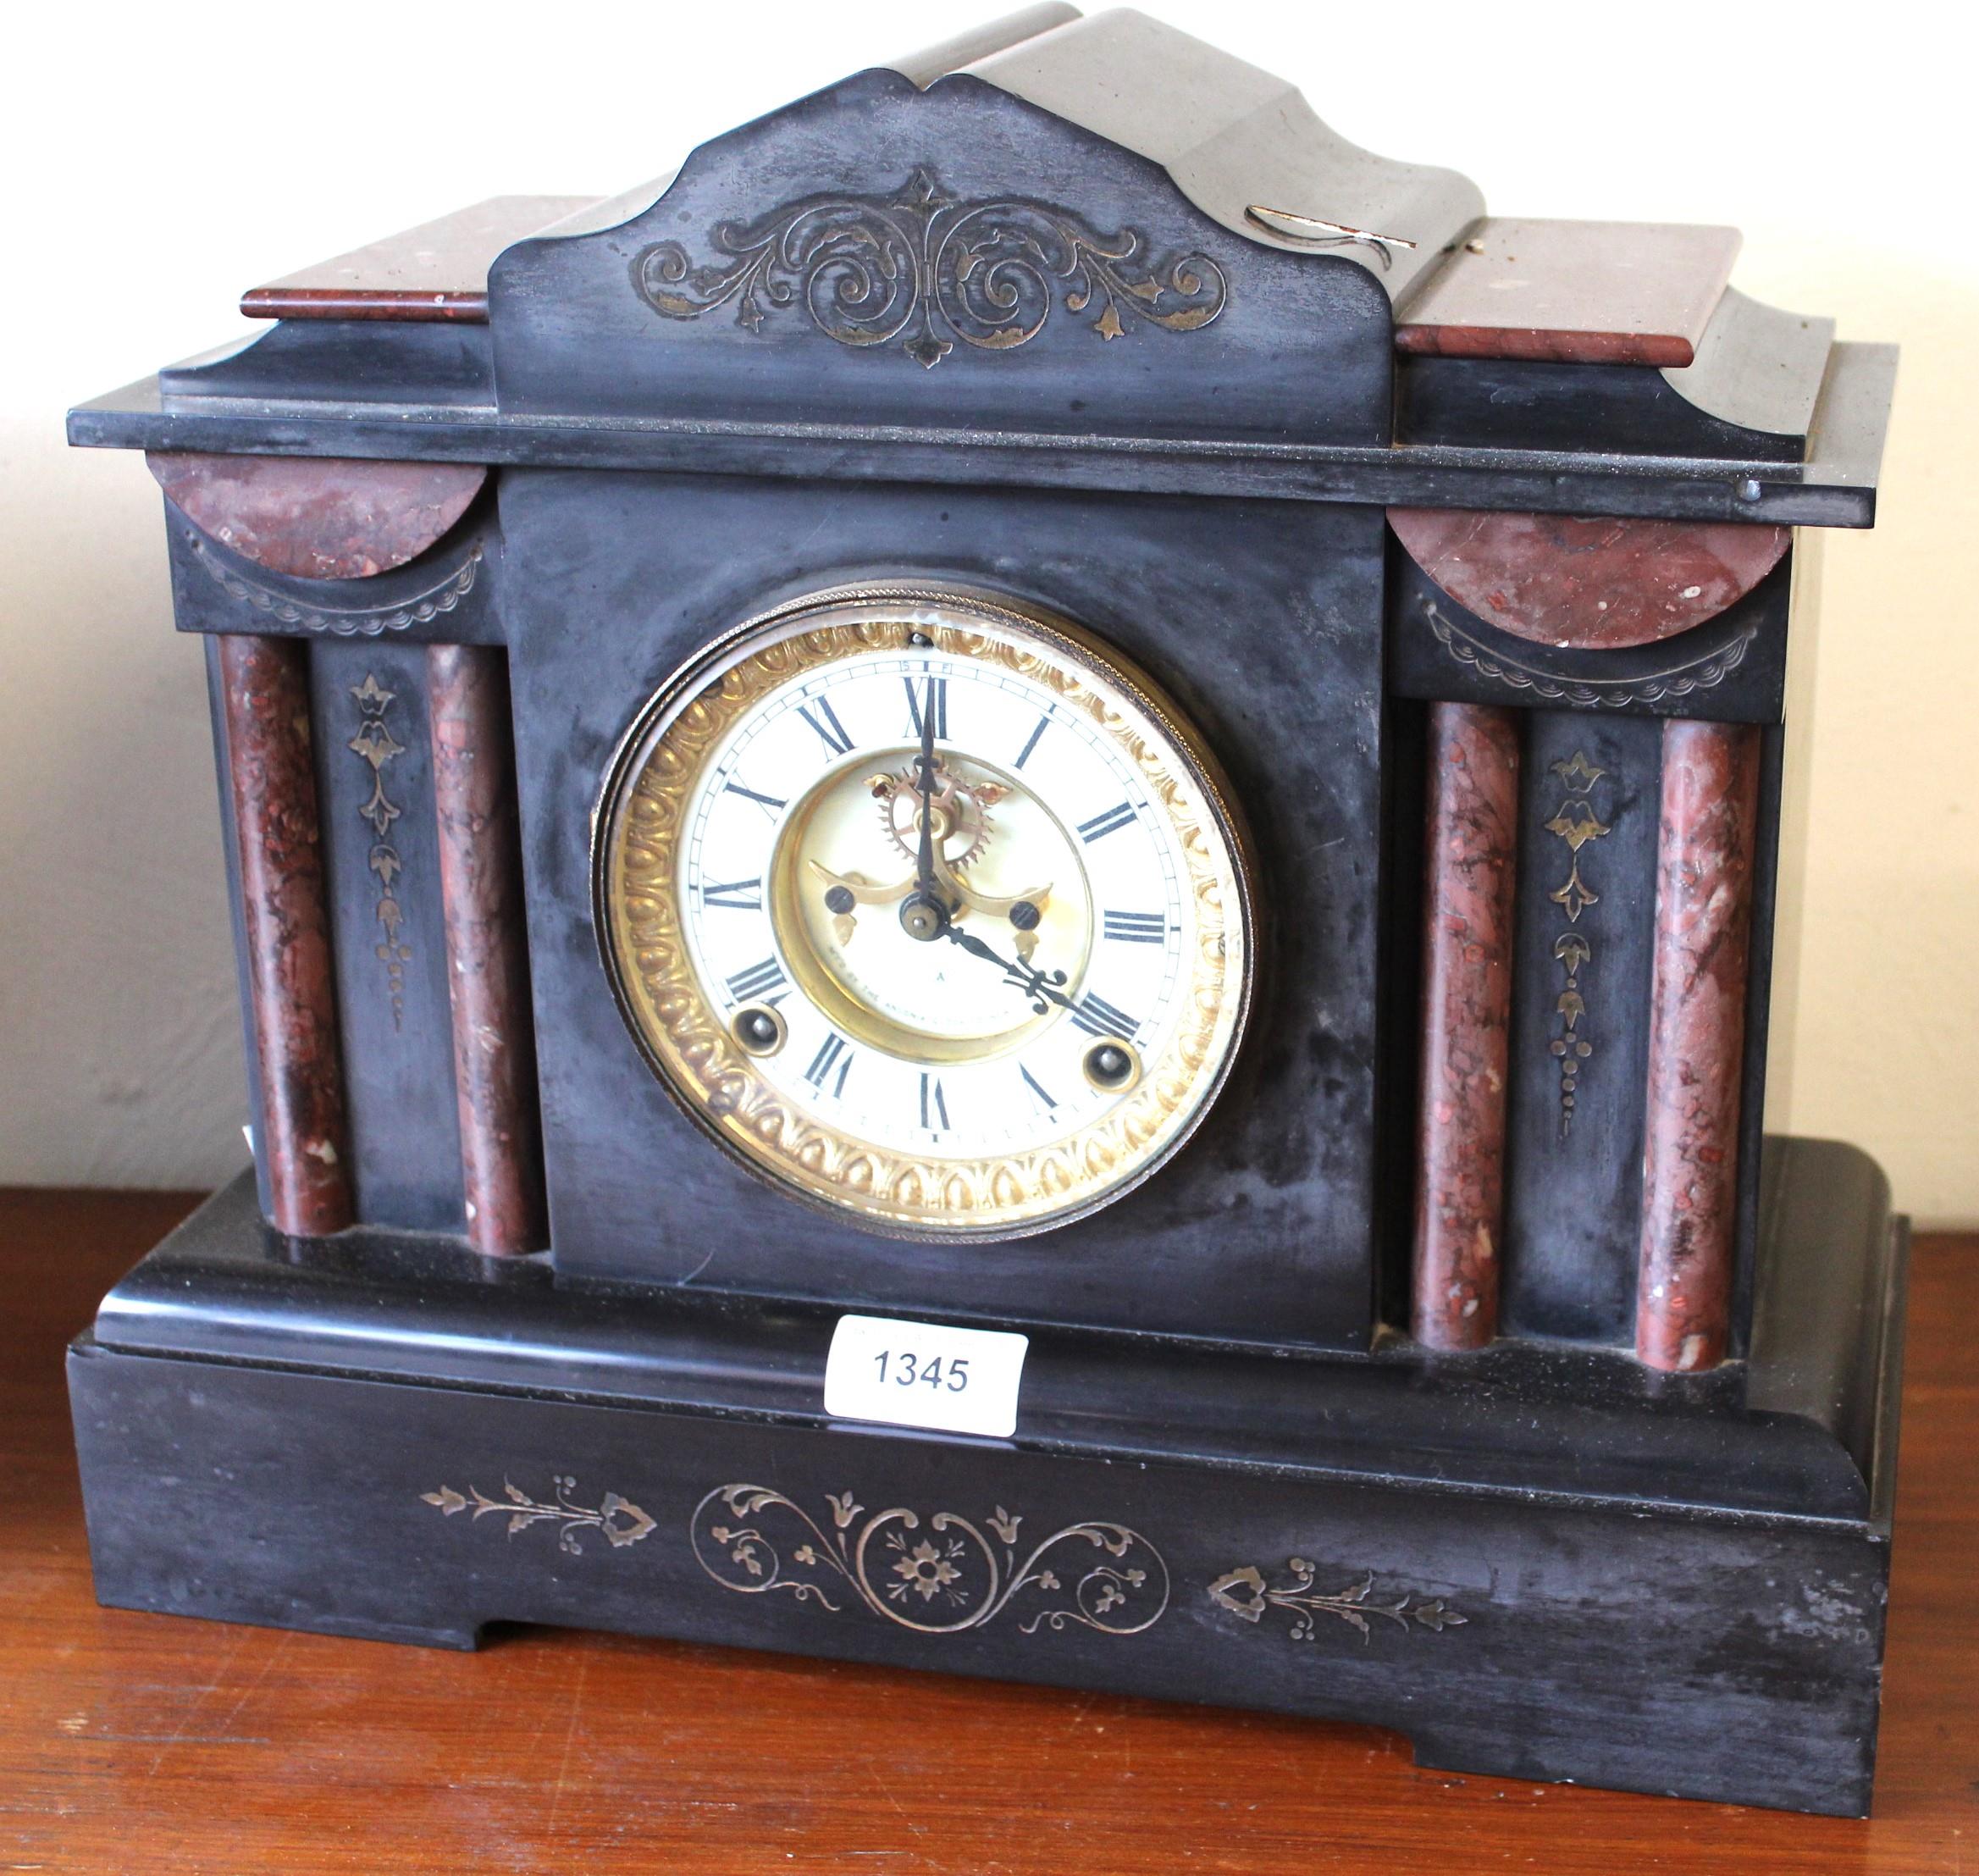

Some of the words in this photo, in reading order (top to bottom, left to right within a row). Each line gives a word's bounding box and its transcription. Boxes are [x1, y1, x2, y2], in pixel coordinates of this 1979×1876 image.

[794, 694, 858, 763] XI
[899, 676, 953, 741] XII
[1010, 714, 1055, 772] I
[722, 767, 789, 826] X
[1074, 798, 1142, 845] II
[703, 872, 761, 912] IX
[1103, 908, 1164, 948] III
[802, 1031, 855, 1100] VII
[1019, 1060, 1059, 1115] V
[919, 1071, 951, 1131] VI
[874, 1350, 970, 1392] 1345
